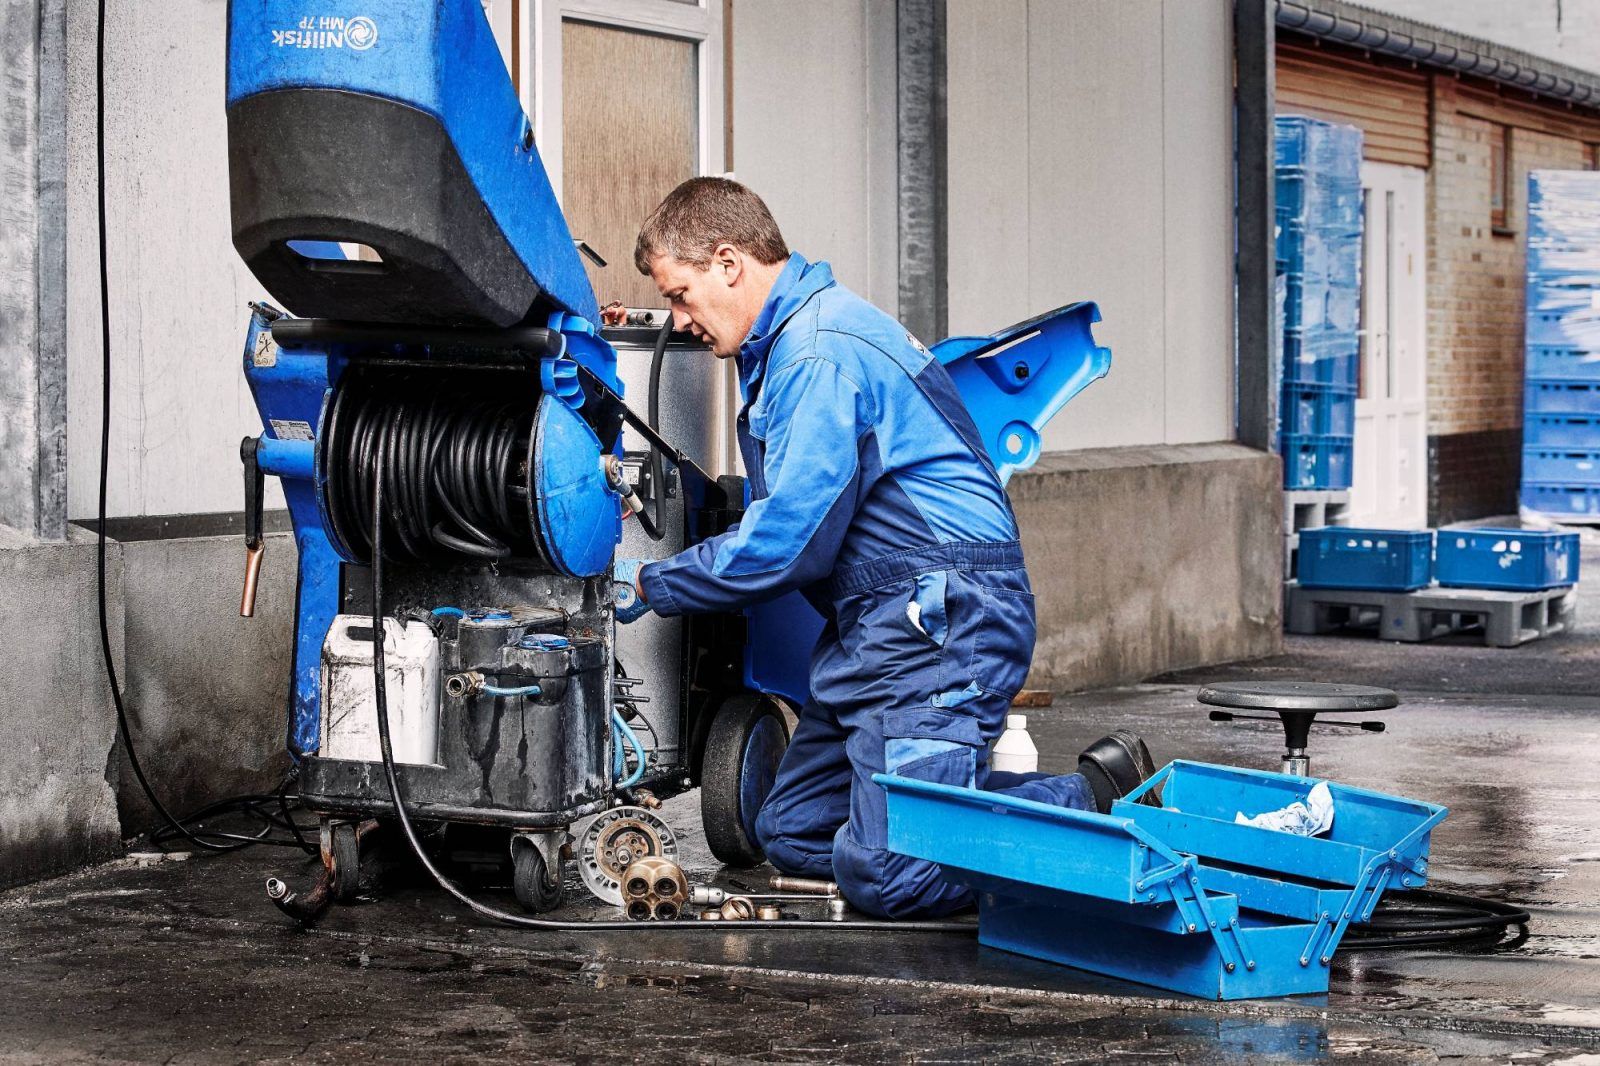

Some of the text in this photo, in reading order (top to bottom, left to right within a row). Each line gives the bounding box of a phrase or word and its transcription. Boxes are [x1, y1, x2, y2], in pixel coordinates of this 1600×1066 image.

[299, 16, 344, 30] MH 7P
[272, 30, 344, 48] Nilfisk
